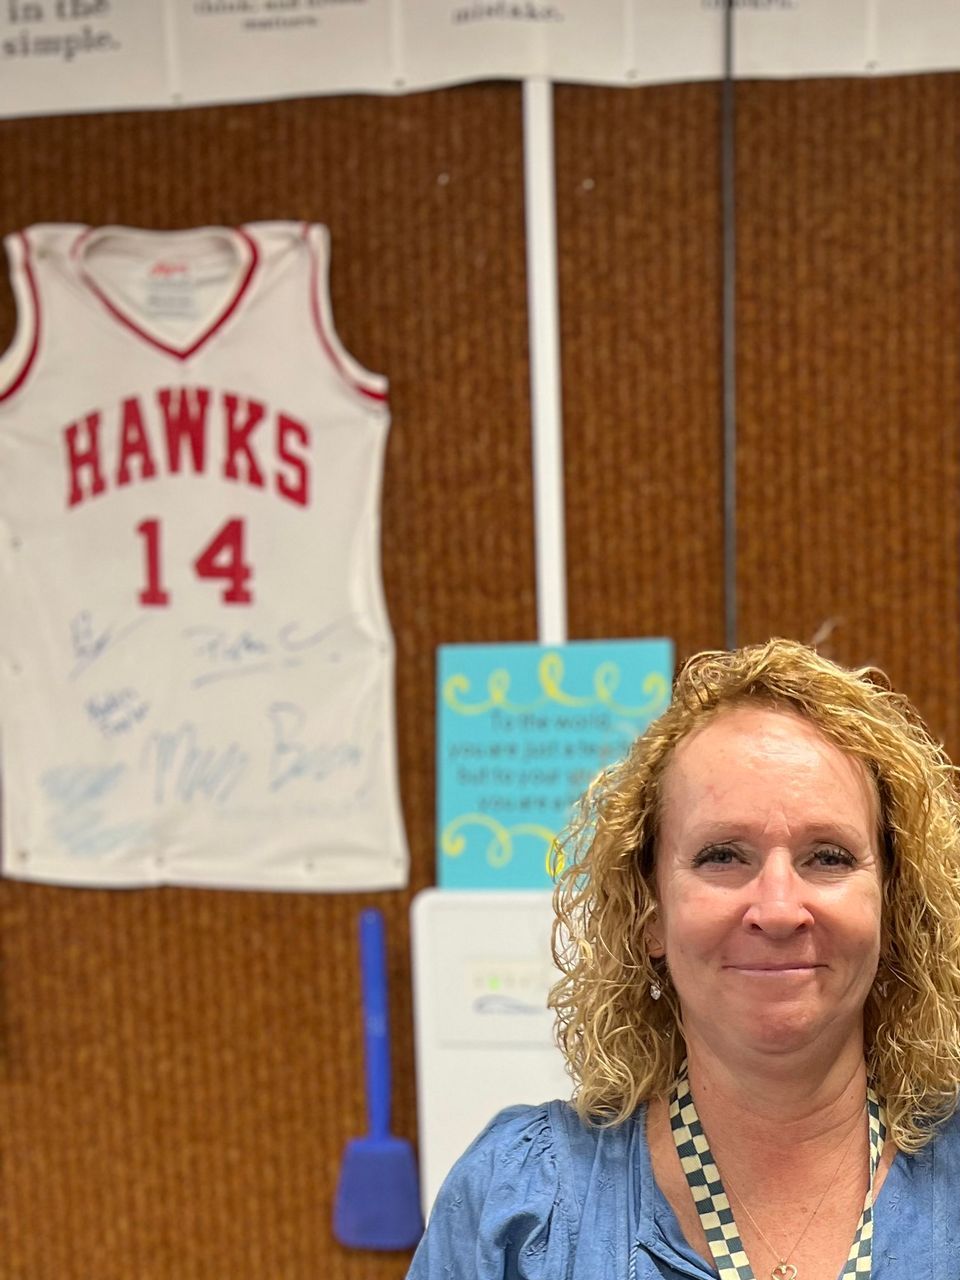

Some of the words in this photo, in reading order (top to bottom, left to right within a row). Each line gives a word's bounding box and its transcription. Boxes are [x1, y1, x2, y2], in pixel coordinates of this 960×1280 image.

[2, 25, 121, 62] simple.
[62, 386, 312, 509] HAWKS
[136, 517, 254, 607] 14
